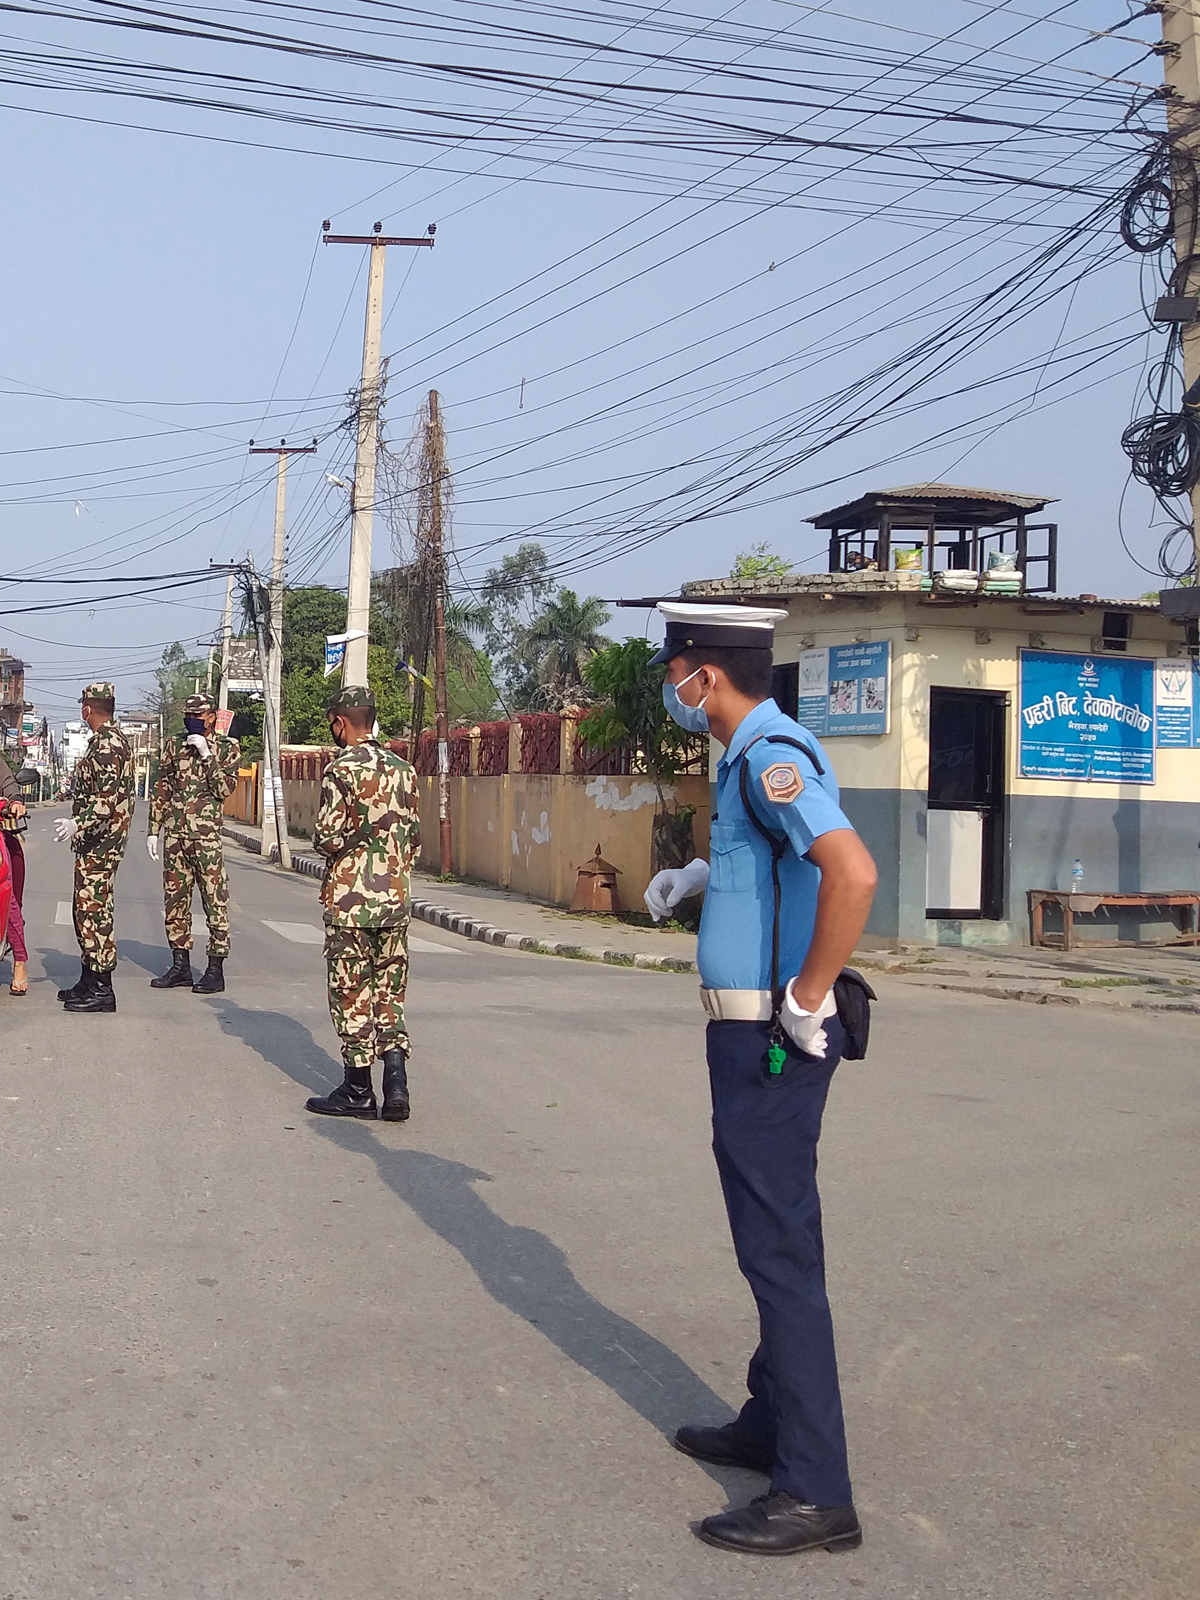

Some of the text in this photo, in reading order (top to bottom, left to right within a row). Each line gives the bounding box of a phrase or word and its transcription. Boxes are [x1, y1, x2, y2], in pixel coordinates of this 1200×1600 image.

[1023, 695, 1055, 729] प्रहरी
[1056, 691, 1080, 717] बिट,
[1083, 690, 1153, 733] देवकोटाचोक
